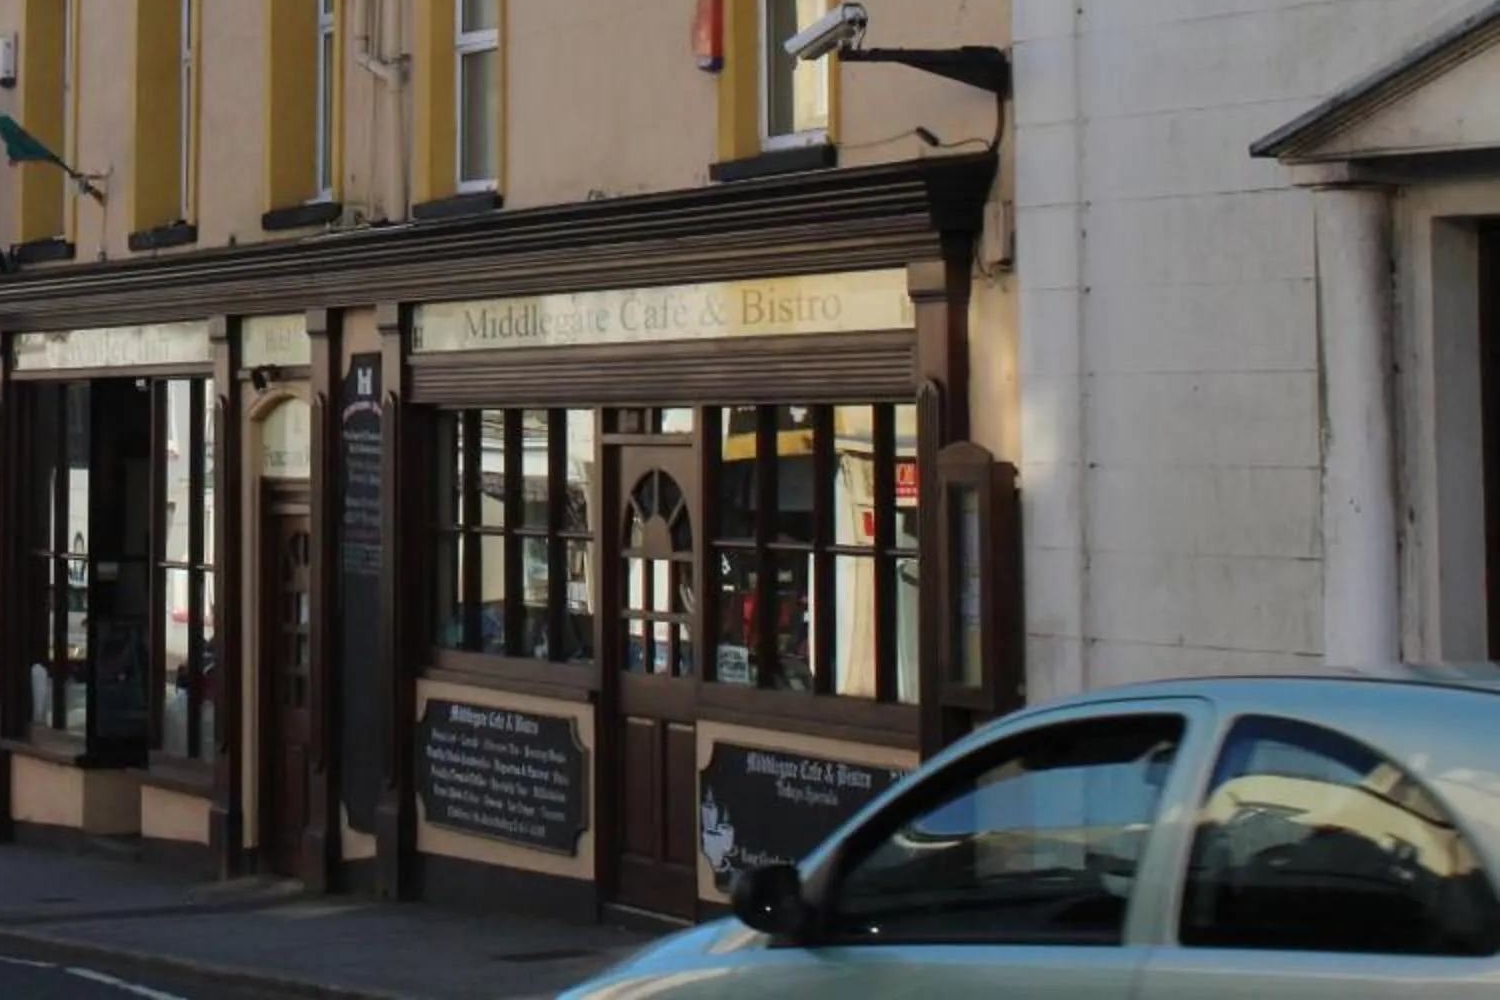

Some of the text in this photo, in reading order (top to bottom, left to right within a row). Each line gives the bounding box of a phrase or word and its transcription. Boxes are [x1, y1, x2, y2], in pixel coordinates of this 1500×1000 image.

[464, 304, 609, 340] Middlegate
[700, 292, 727, 327] &
[740, 287, 842, 326] Bistro
